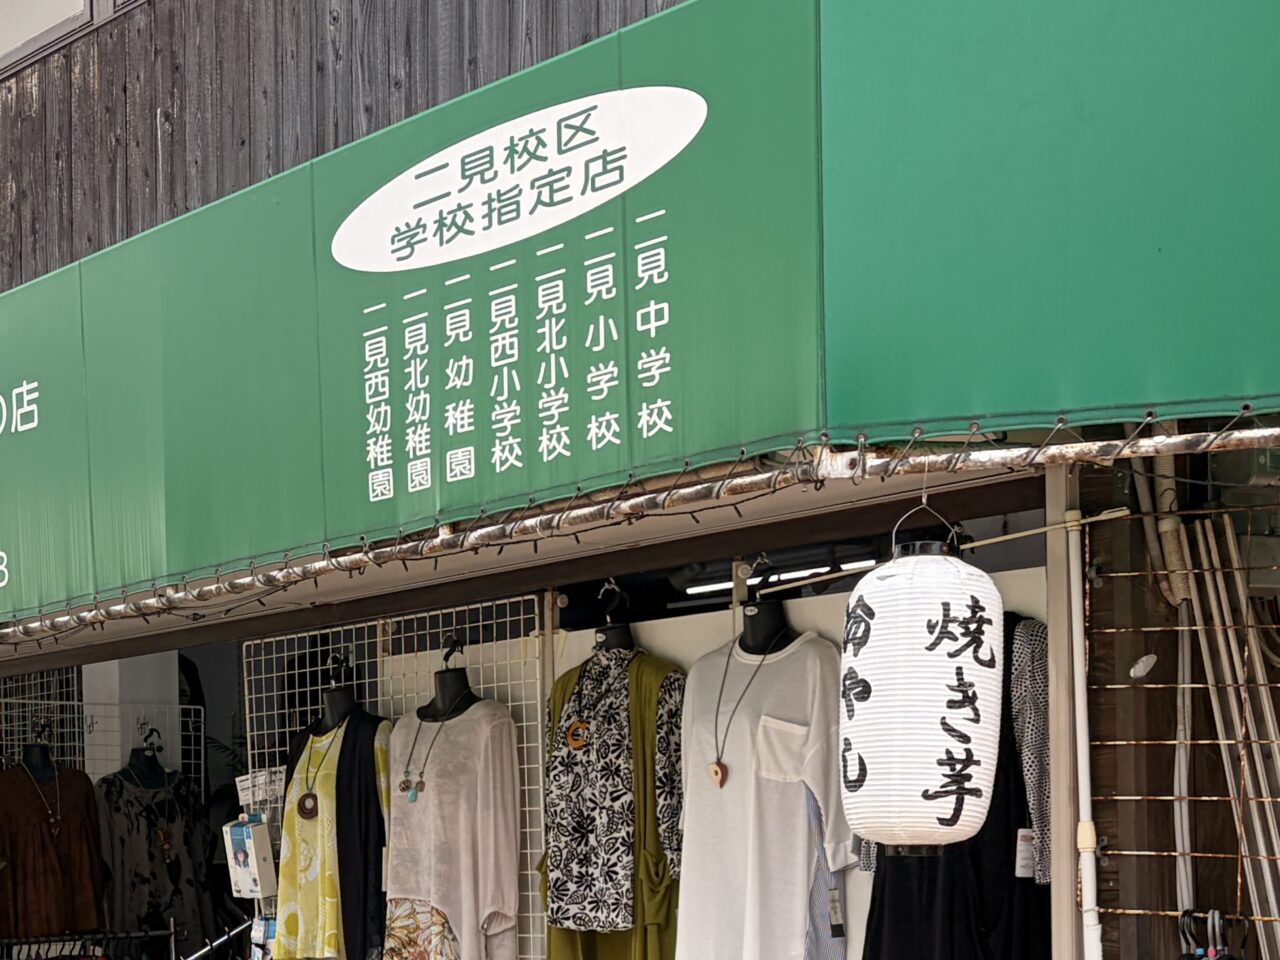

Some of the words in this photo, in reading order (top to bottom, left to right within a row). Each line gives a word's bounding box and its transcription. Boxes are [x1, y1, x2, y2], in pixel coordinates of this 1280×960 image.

[389, 146, 629, 262] 学校指定店
[413, 105, 600, 210] 二見校区
[363, 303, 394, 502] 二見西幼稚園
[402, 289, 433, 493] 二見北幼稚園
[444, 274, 476, 483] 二見幼稚園
[488, 259, 524, 473] 二見西小学校
[535, 244, 571, 462] 二見北小学校
[584, 226, 621, 451] 二見小学校
[634, 209, 674, 439] 二見中学校
[921, 595, 997, 827] 焼き芋
